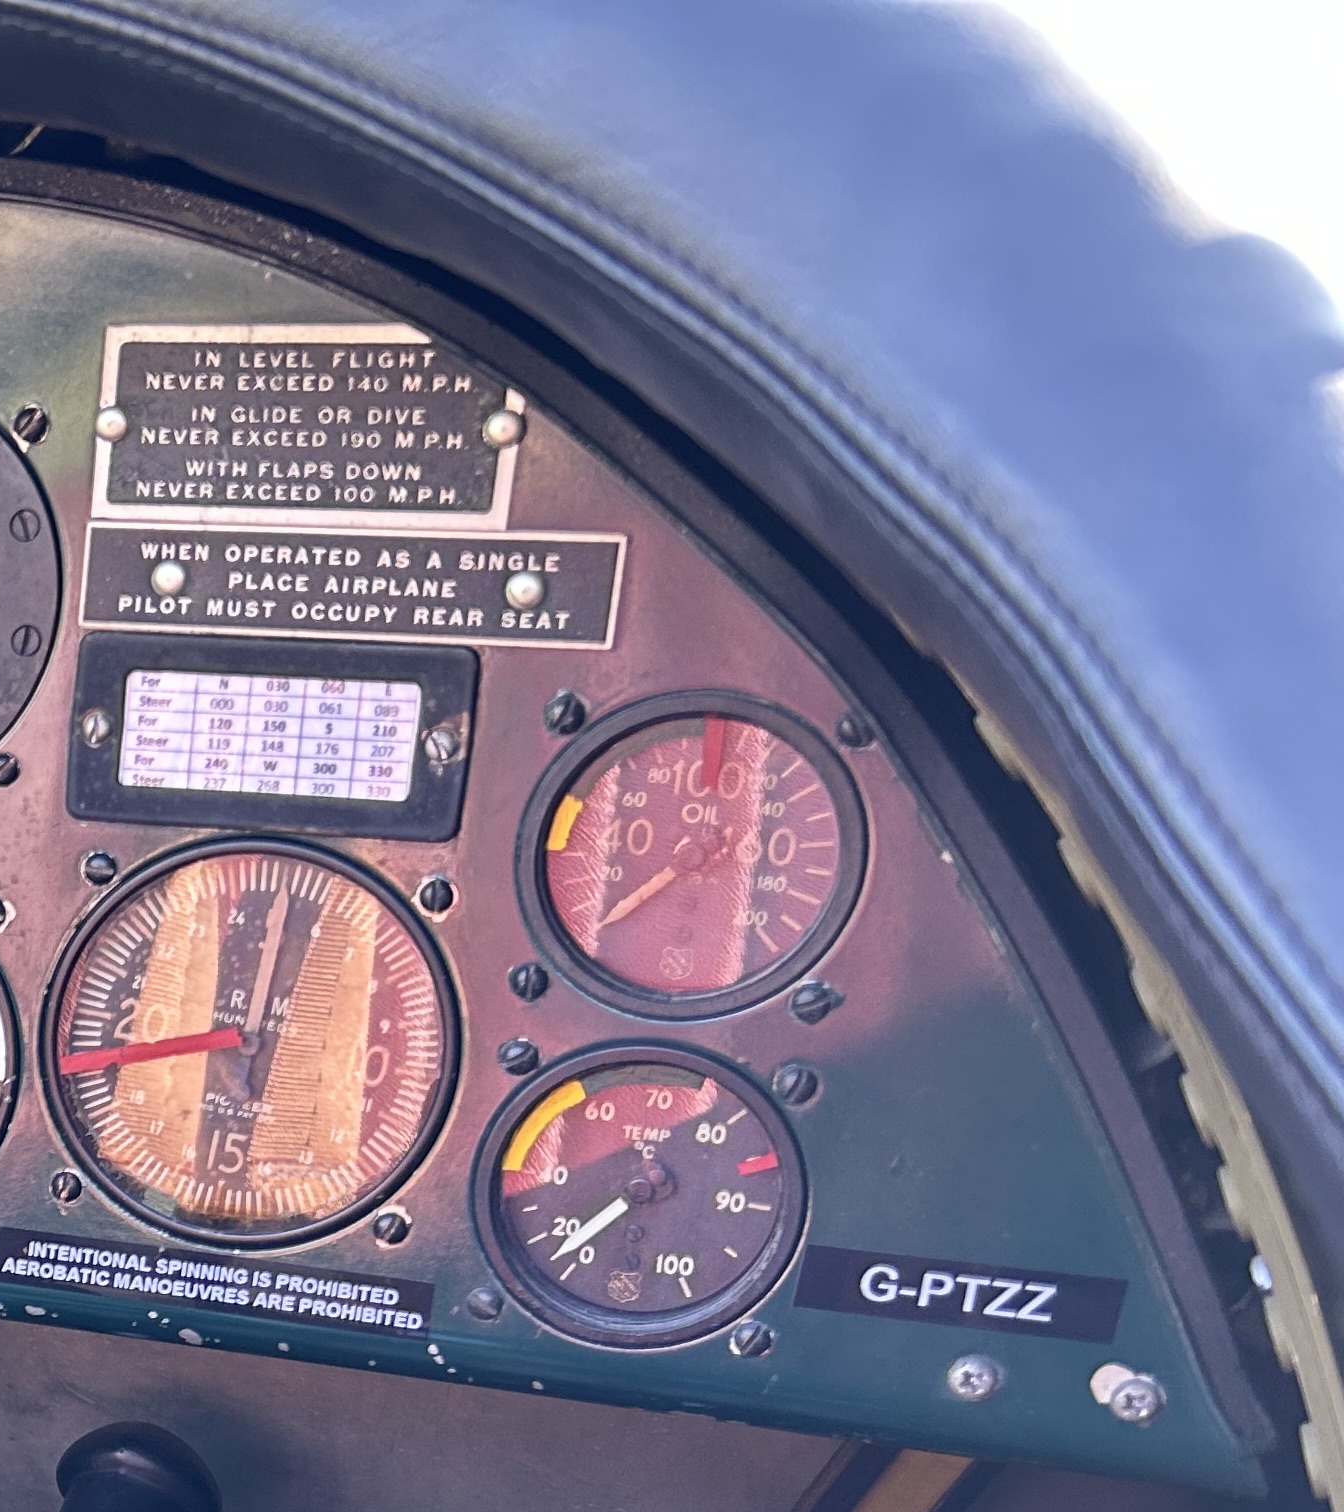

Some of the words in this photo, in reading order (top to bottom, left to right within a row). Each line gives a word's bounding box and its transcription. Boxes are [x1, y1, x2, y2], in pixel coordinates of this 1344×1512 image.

[194, 349, 221, 368] IN
[239, 350, 314, 369] LEVEL
[332, 350, 438, 369] FLIGHT
[144, 373, 225, 391] NEVER
[237, 374, 335, 393] EXCEED
[347, 375, 388, 393] 140
[191, 406, 215, 423] IN
[230, 407, 303, 425] GLIDE
[317, 407, 352, 426] OR
[367, 408, 427, 426] DIVE
[140, 428, 220, 446] NEVER
[231, 429, 328, 448] EXCEED
[340, 430, 382, 449] 190
[185, 459, 248, 477] WITH
[258, 460, 334, 480] FLAPS
[345, 462, 422, 481] DOWN
[135, 481, 223, 499] NEVER
[226, 483, 321, 502] EXCEED
[334, 484, 375, 503] 100
[140, 542, 210, 563] WHEN
[224, 544, 362, 568] OPERATED
[376, 548, 410, 570] AS
[425, 550, 443, 571] A
[458, 550, 561, 573] SINGLE
[228, 571, 310, 593] PLACE
[324, 575, 457, 598] AIRPLANE
[118, 595, 193, 616] PILOT
[206, 597, 277, 619] MUST
[292, 601, 398, 625] OCCUPY
[412, 607, 483, 628] REAR
[500, 609, 570, 630] SEAT
[141, 675, 161, 688] For
[139, 695, 172, 708] Steer
[137, 714, 158, 727] For
[208, 718, 233, 731] 120
[372, 724, 398, 738] 210
[136, 734, 169, 748] Steer
[134, 754, 155, 767] For
[312, 762, 338, 776] 300
[368, 765, 394, 778] 330
[622, 791, 647, 808] 60
[681, 802, 719, 825] OIL
[756, 875, 788, 893] 180
[113, 998, 169, 1043] 20
[646, 1088, 673, 1110] 70
[584, 1101, 615, 1122] 60
[622, 1124, 671, 1143] TEMP
[695, 1122, 727, 1145] 80
[206, 1129, 249, 1175] 15
[715, 1190, 746, 1213] 90
[551, 1216, 581, 1237] 20
[578, 1245, 596, 1265] 0
[654, 1253, 695, 1277] 100
[28, 1240, 151, 1274] INTENTIONAL
[155, 1256, 249, 1287] SPINNING
[252, 1269, 272, 1288] IS
[276, 1273, 400, 1306] PROHIBITED
[1, 1256, 111, 1288] AEROBATIC
[113, 1272, 250, 1306] MANOEUVRES
[253, 1290, 296, 1312] ARE
[299, 1296, 423, 1330] PROHIBITED
[859, 1263, 1058, 1323] G-PTZZ
